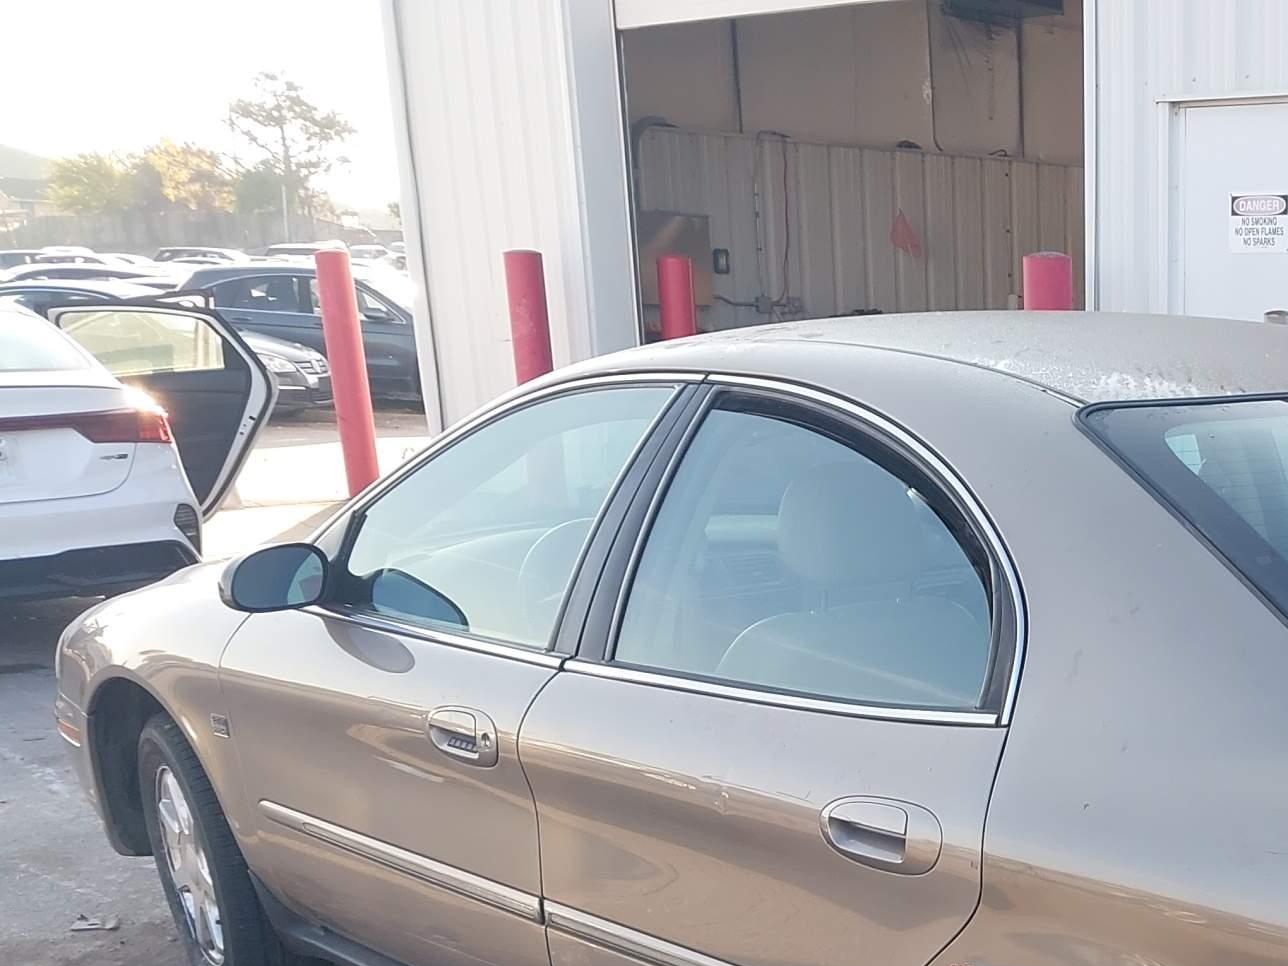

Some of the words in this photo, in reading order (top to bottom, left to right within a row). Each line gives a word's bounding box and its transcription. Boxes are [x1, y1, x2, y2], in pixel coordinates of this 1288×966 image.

[1239, 199, 1280, 212] DANGER
[1241, 217, 1250, 226] NO
[1251, 216, 1278, 226] SMOKING
[1234, 227, 1243, 236] NO
[1244, 227, 1260, 236] OPEN
[1261, 226, 1284, 236] FLAMES
[1243, 237, 1251, 246] NO
[1252, 237, 1276, 246] SPARKS
